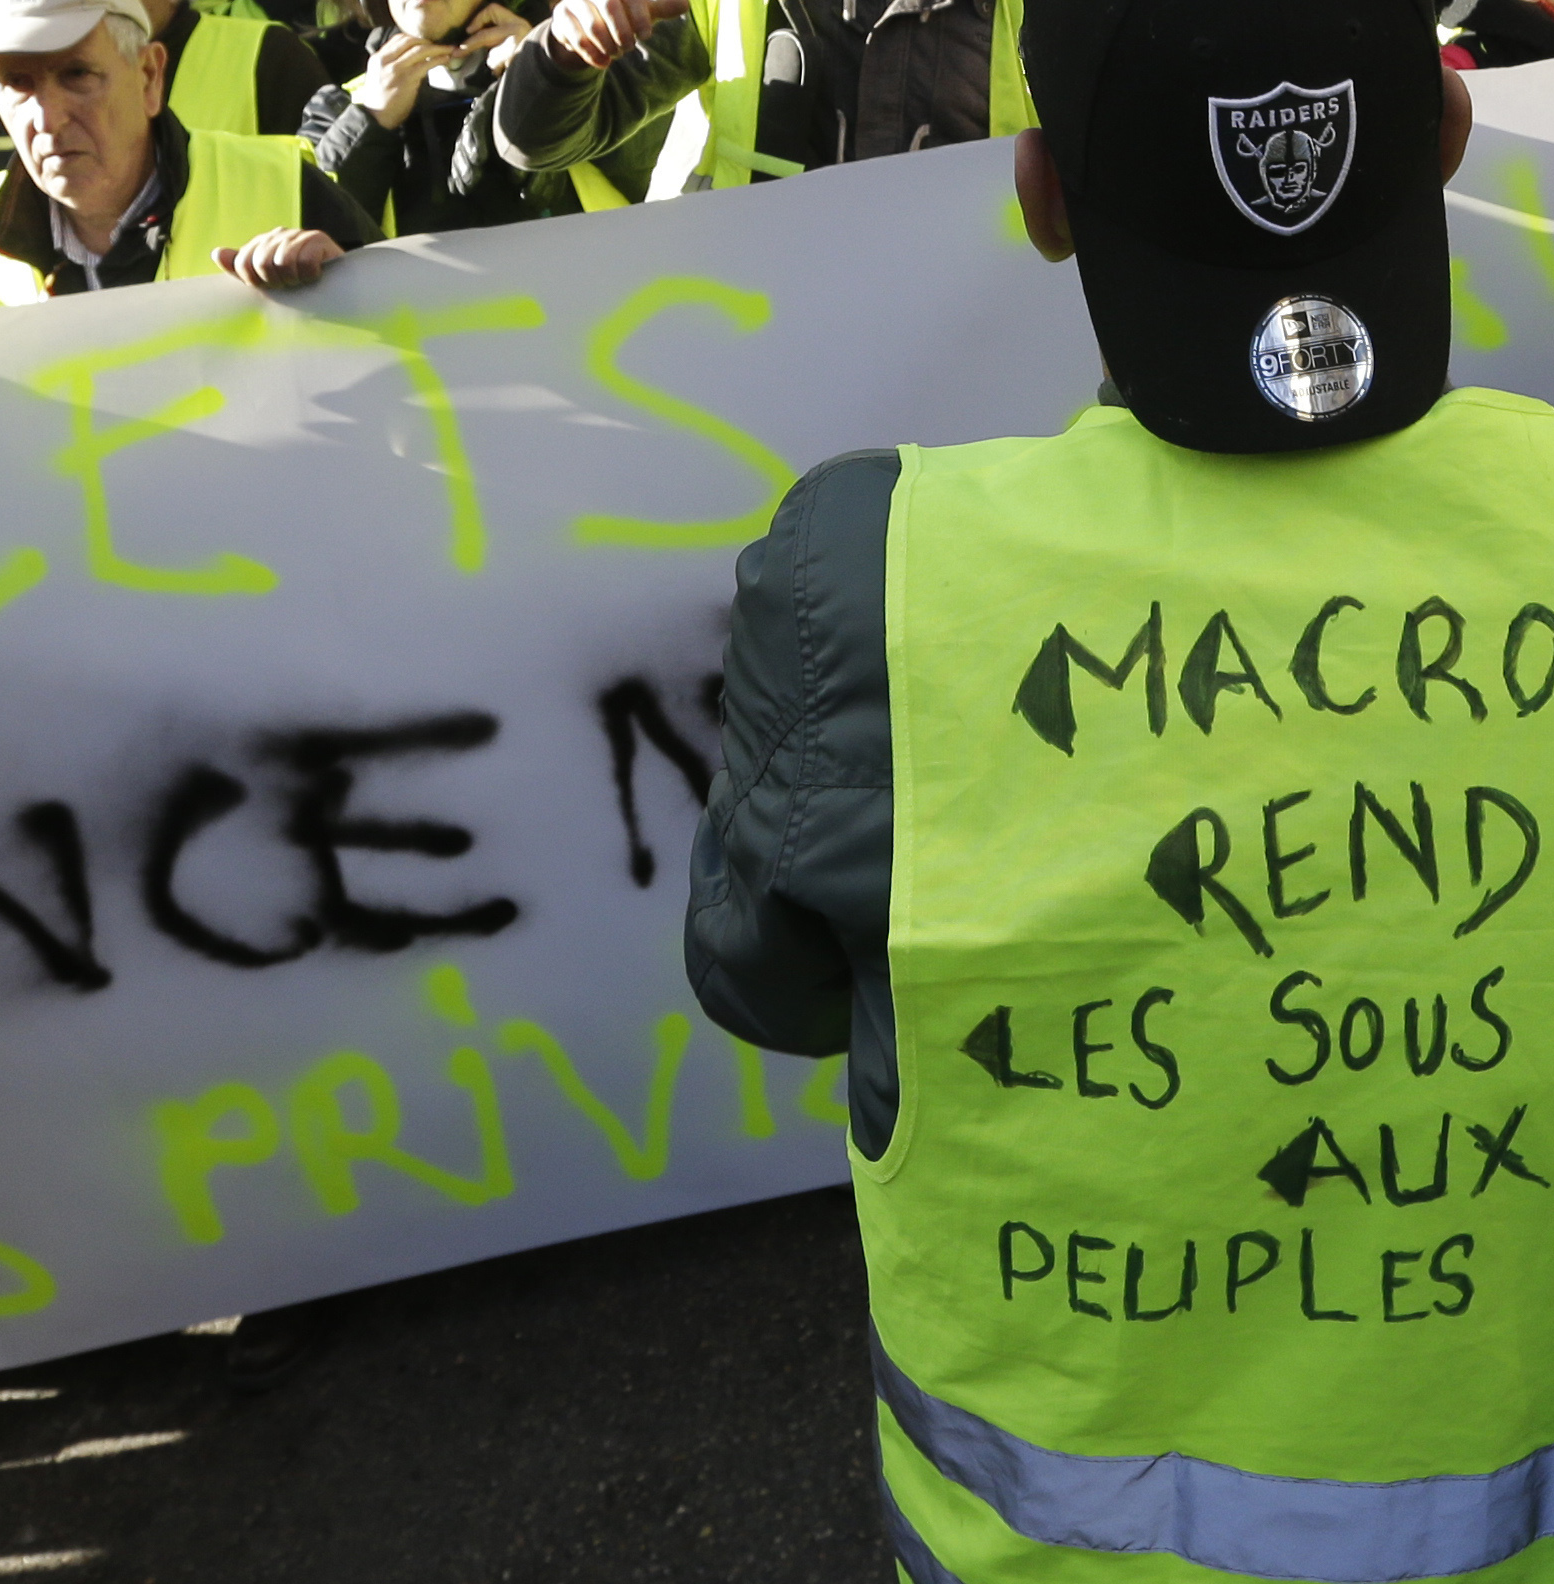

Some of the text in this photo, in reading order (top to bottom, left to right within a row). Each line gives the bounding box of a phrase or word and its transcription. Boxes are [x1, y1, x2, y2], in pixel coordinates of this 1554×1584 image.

[1230, 96, 1341, 130] RAIDERS
[1310, 312, 1331, 323] NEW
[1311, 320, 1332, 332] ERA
[1258, 338, 1364, 378] 9FORTY
[1291, 378, 1351, 399] ADJUSTABLE
[1143, 780, 1541, 959] REND
[957, 965, 1514, 1111] LES SOUS
[1256, 1103, 1551, 1209] AUX
[997, 1219, 1477, 1323] PEUPLES
